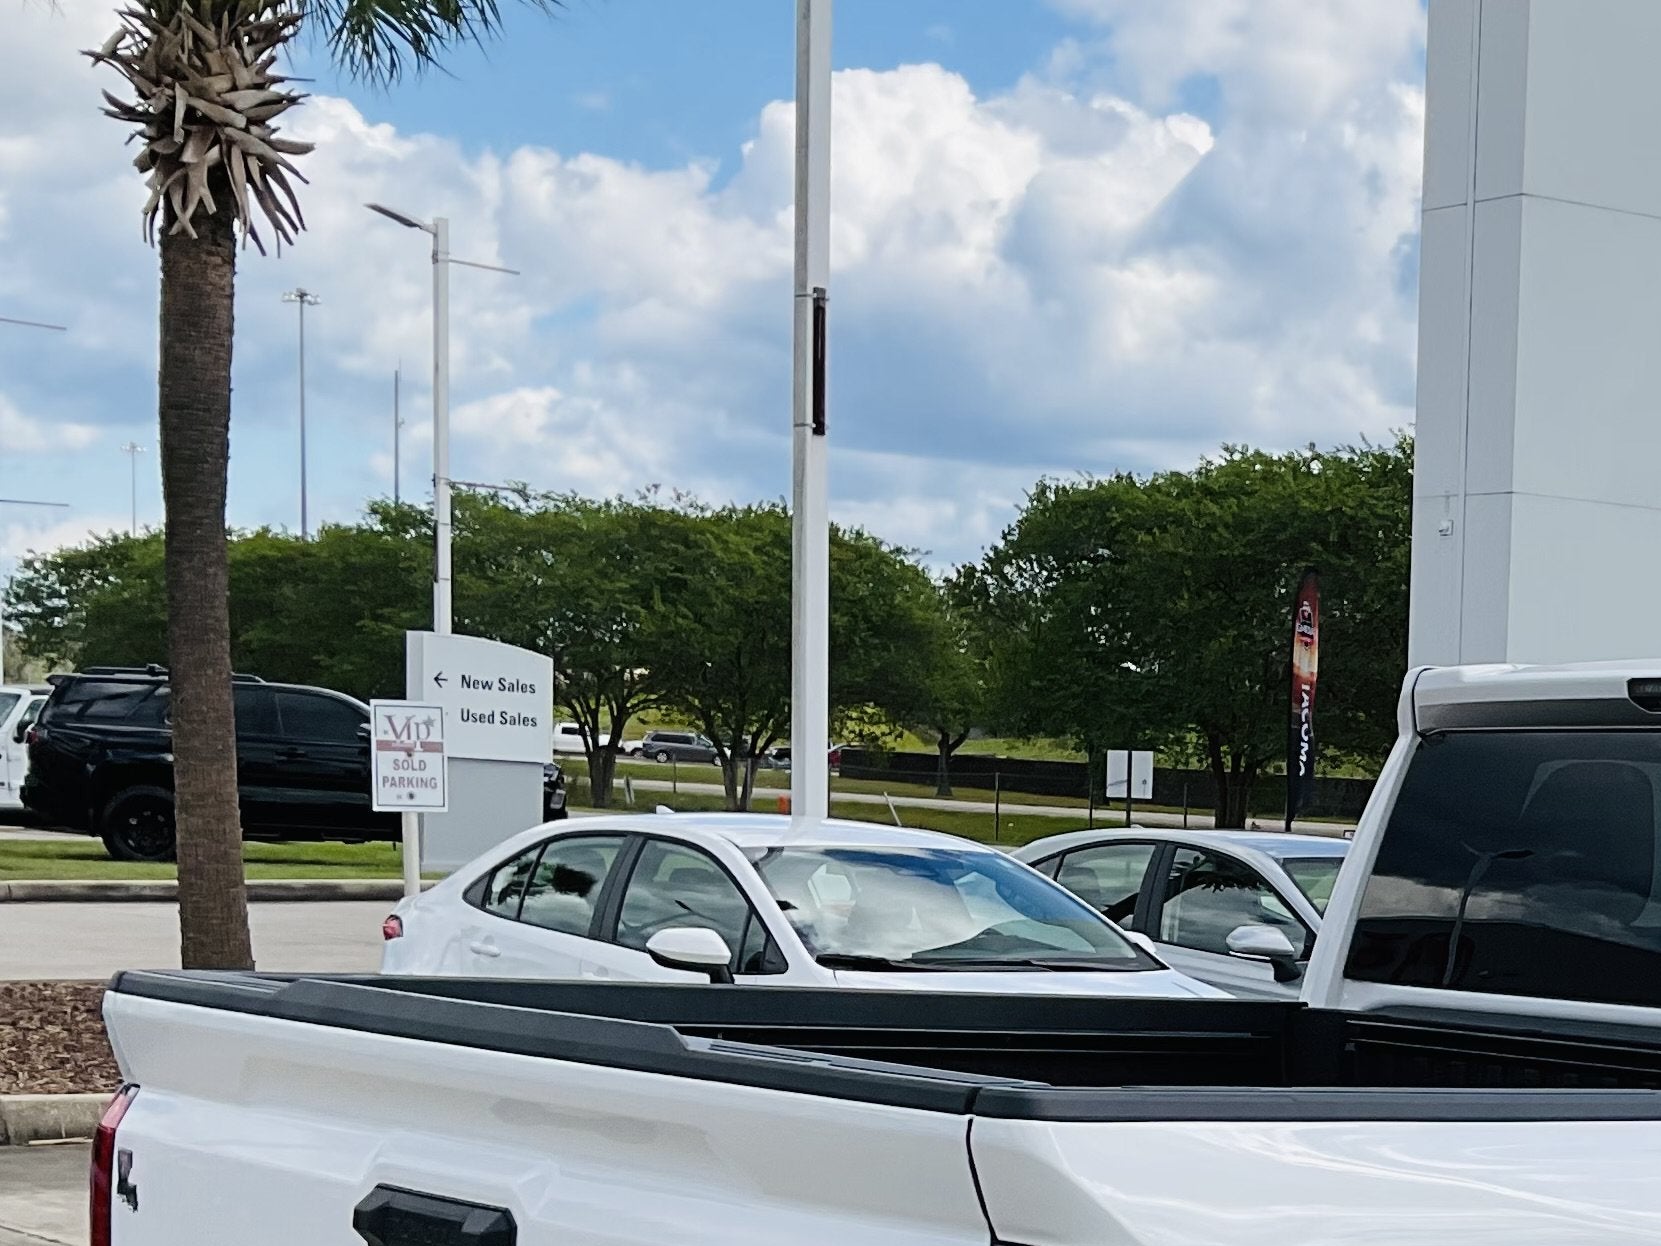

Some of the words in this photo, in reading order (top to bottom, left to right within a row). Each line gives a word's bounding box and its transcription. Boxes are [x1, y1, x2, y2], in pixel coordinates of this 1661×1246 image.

[460, 674, 494, 690] New
[498, 677, 536, 694] Sales
[460, 708, 495, 724] Used
[499, 710, 538, 727] Sales
[393, 758, 427, 772] SOLD
[382, 775, 438, 789] PARKING
